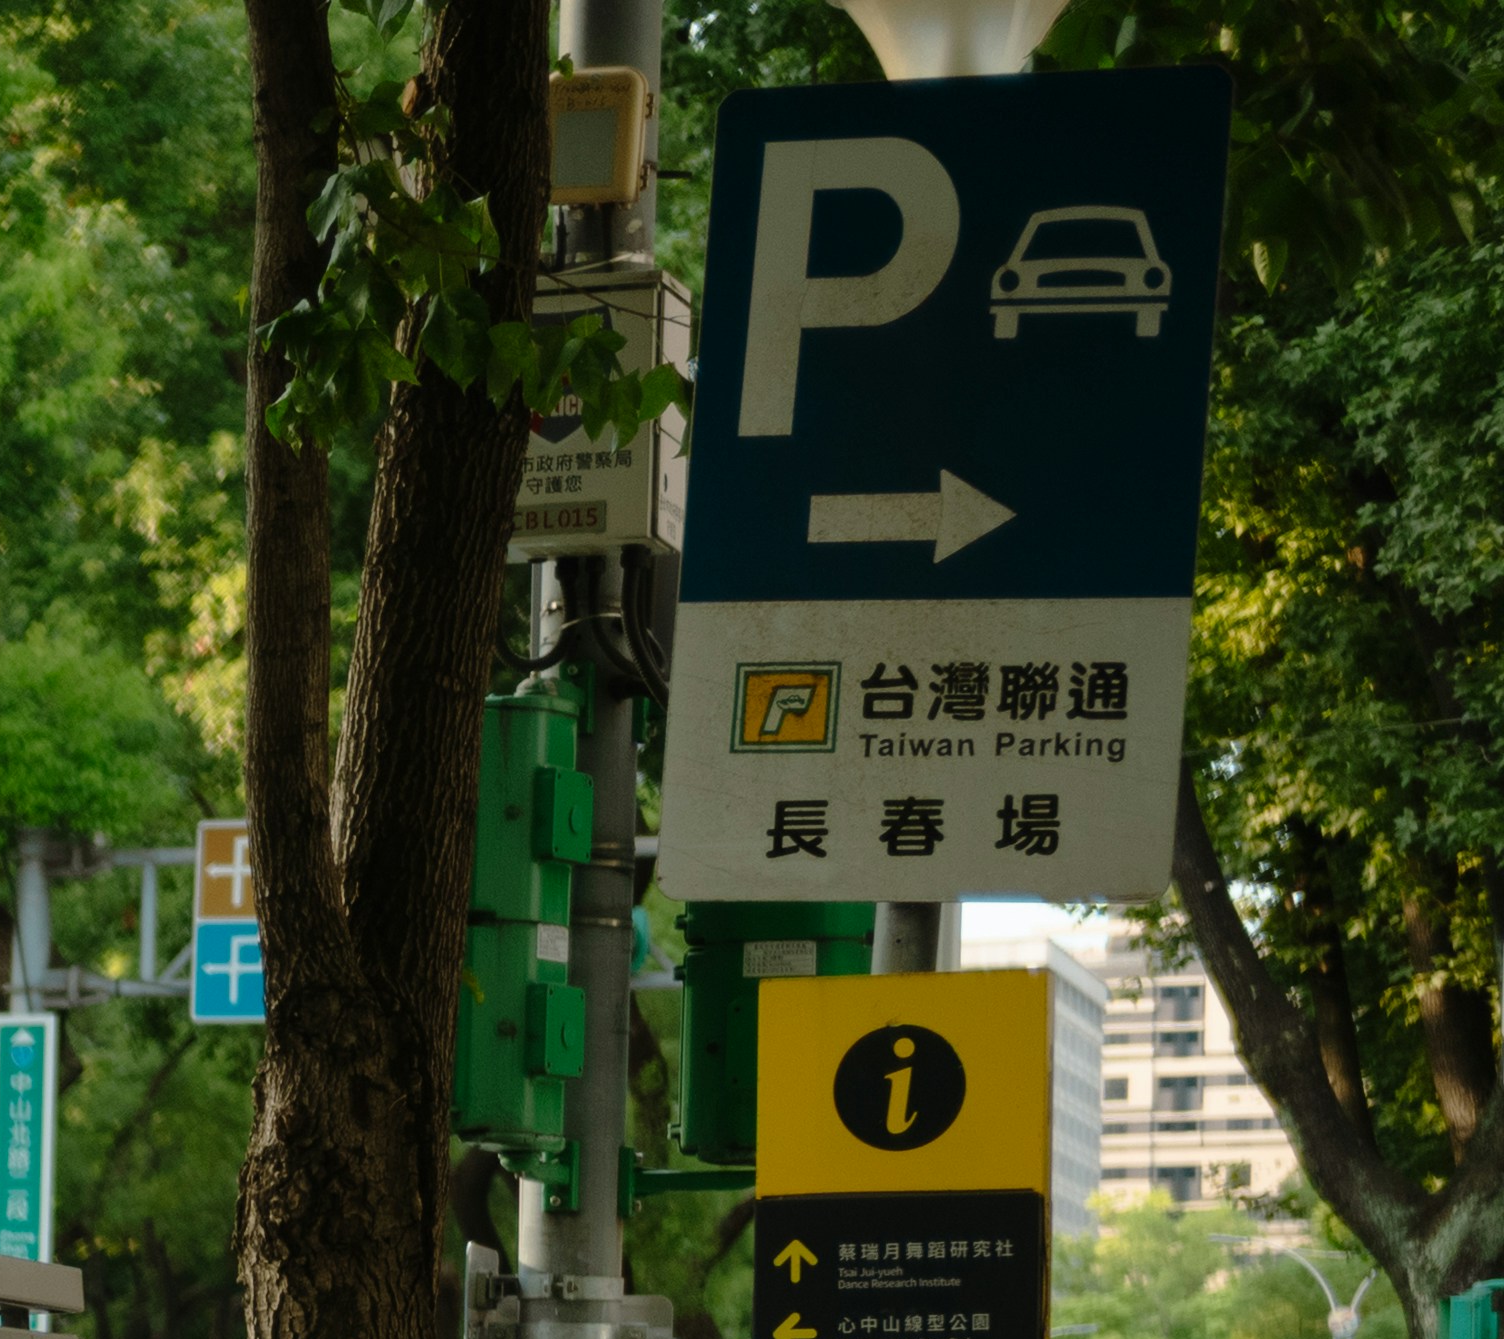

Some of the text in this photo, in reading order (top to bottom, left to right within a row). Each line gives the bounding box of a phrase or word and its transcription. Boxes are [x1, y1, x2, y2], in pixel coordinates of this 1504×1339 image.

[860, 661, 1129, 722] 台灣聯通
[860, 733, 1127, 763] Taiwan Parking
[767, 794, 1060, 859] 長春場
[838, 1267, 858, 1278] Tsai
[838, 1277, 962, 1289] Dance Research Institute
[838, 1313, 990, 1334] 心中山線型公園
